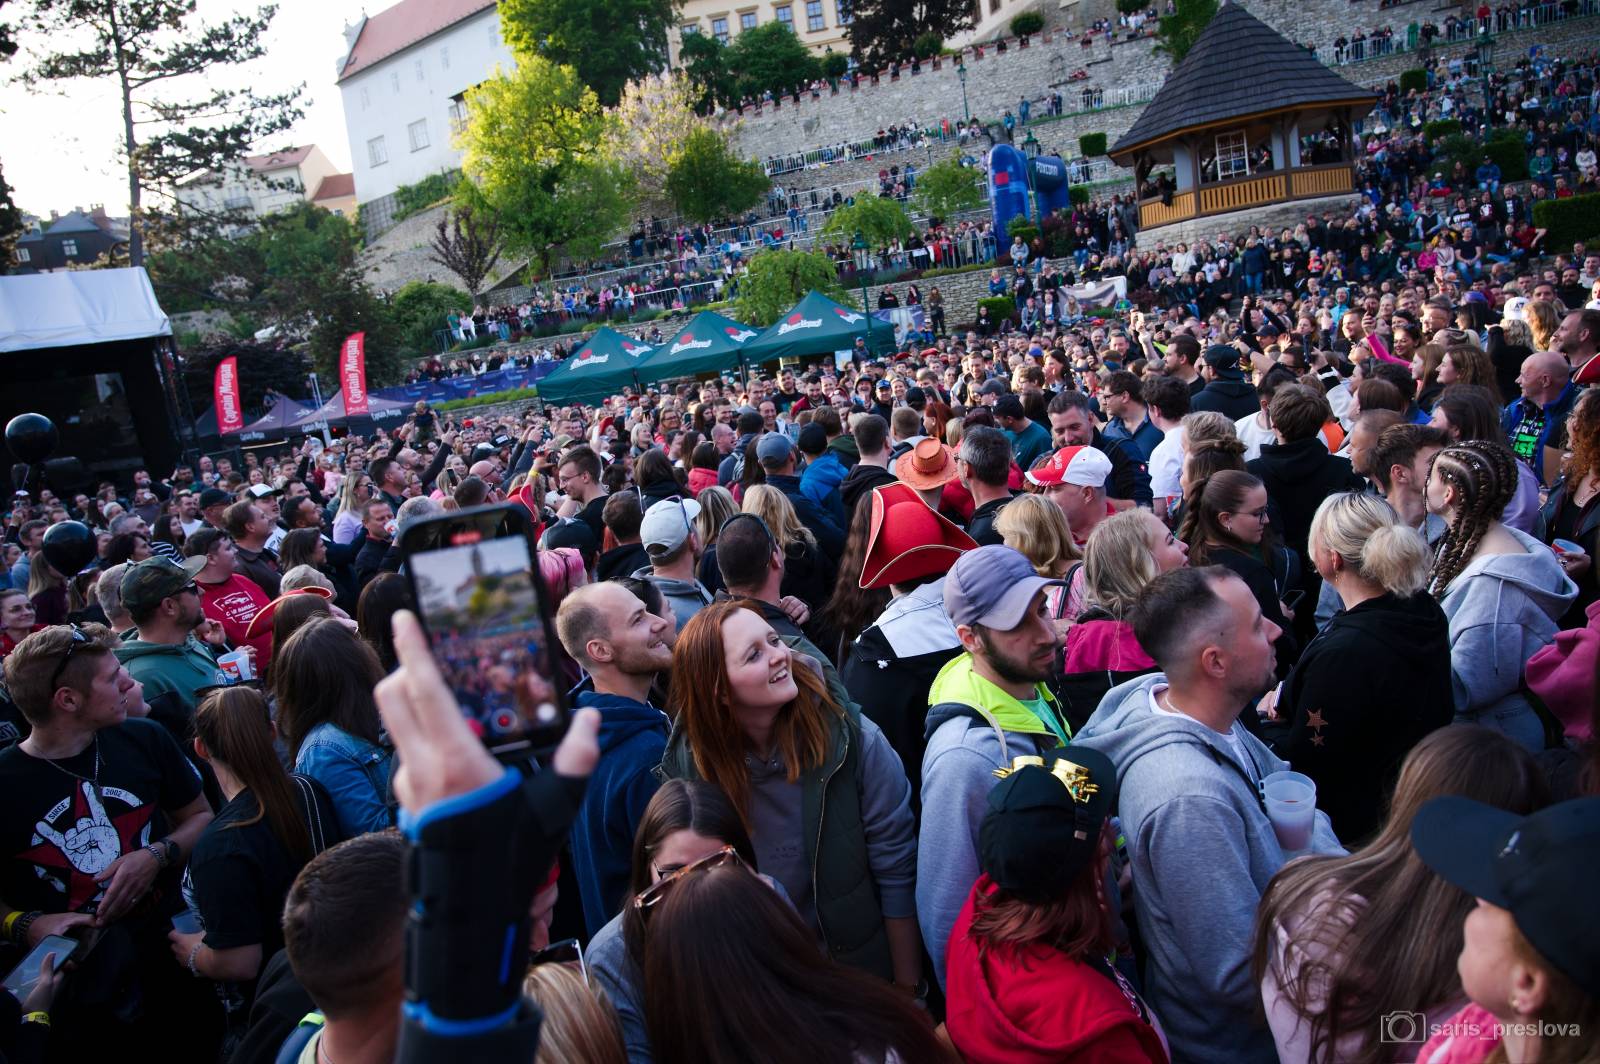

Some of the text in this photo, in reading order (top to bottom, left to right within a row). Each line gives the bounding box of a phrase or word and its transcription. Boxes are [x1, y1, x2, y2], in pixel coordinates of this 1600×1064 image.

[345, 339, 361, 375] Morgan
[219, 364, 235, 396] Morgan
[347, 373, 364, 403] Captain
[222, 395, 239, 423] Captain
[105, 788, 123, 797] 2002
